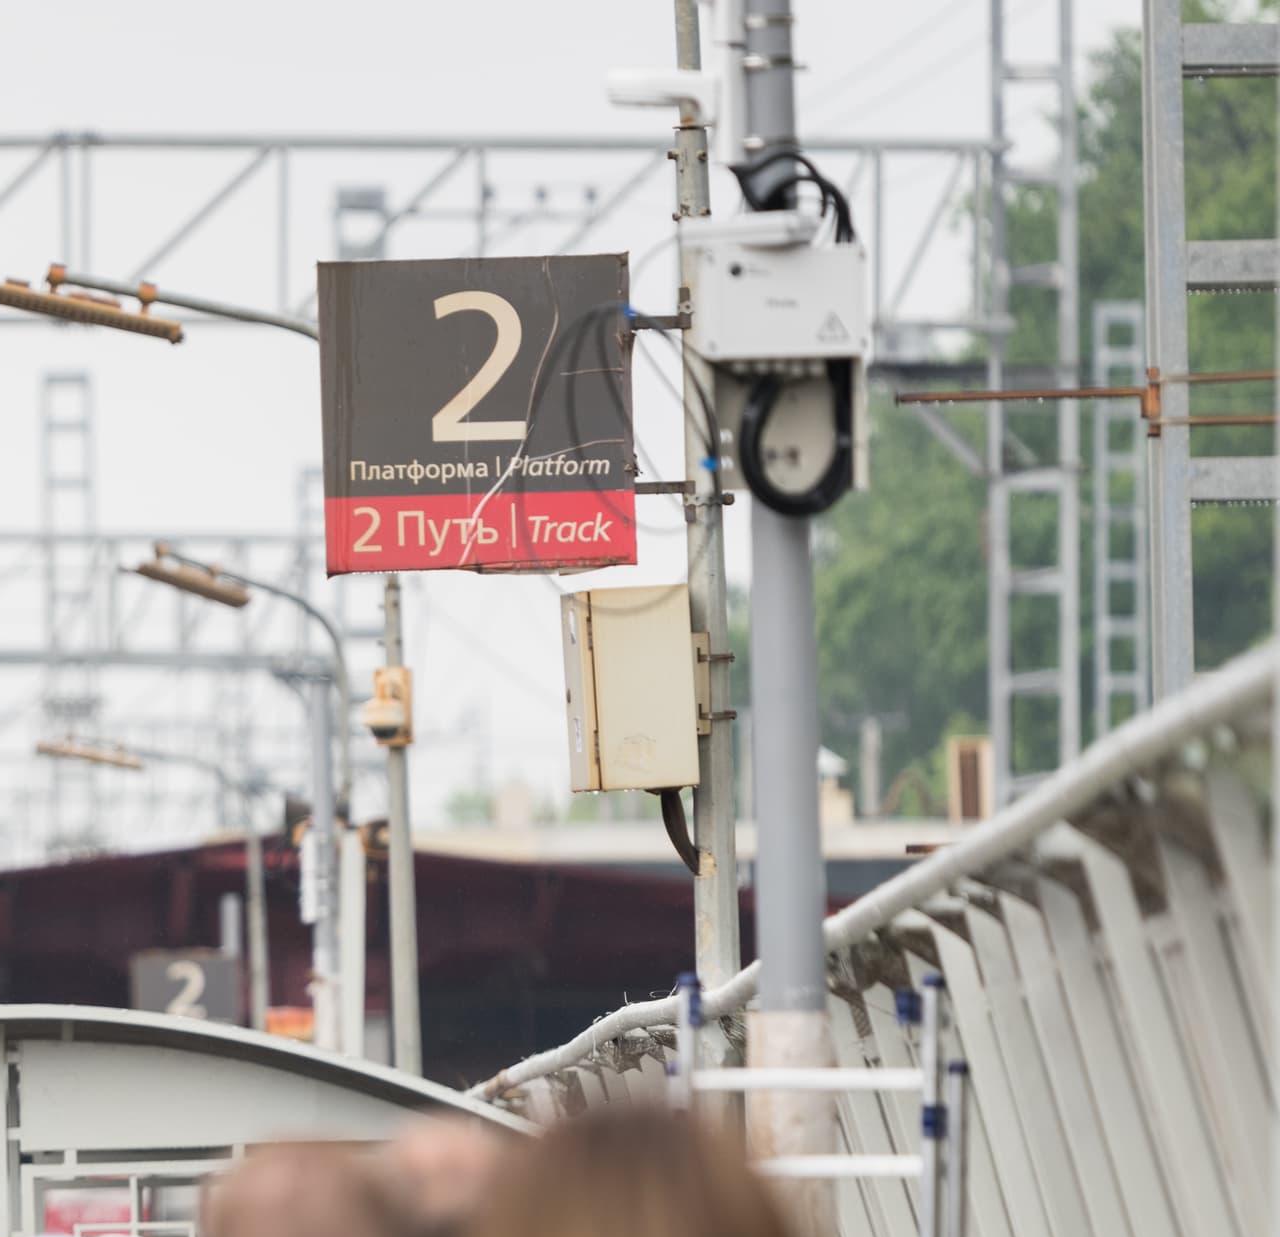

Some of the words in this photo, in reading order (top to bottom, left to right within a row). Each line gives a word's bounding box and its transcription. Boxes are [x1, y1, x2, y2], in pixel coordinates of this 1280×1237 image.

[432, 290, 527, 442] 2
[351, 460, 489, 485] Платформа
[509, 455, 610, 477] Platform
[352, 507, 383, 553] 2
[398, 511, 499, 556] Путь
[528, 512, 613, 543] Track
[166, 960, 208, 1019] 2
